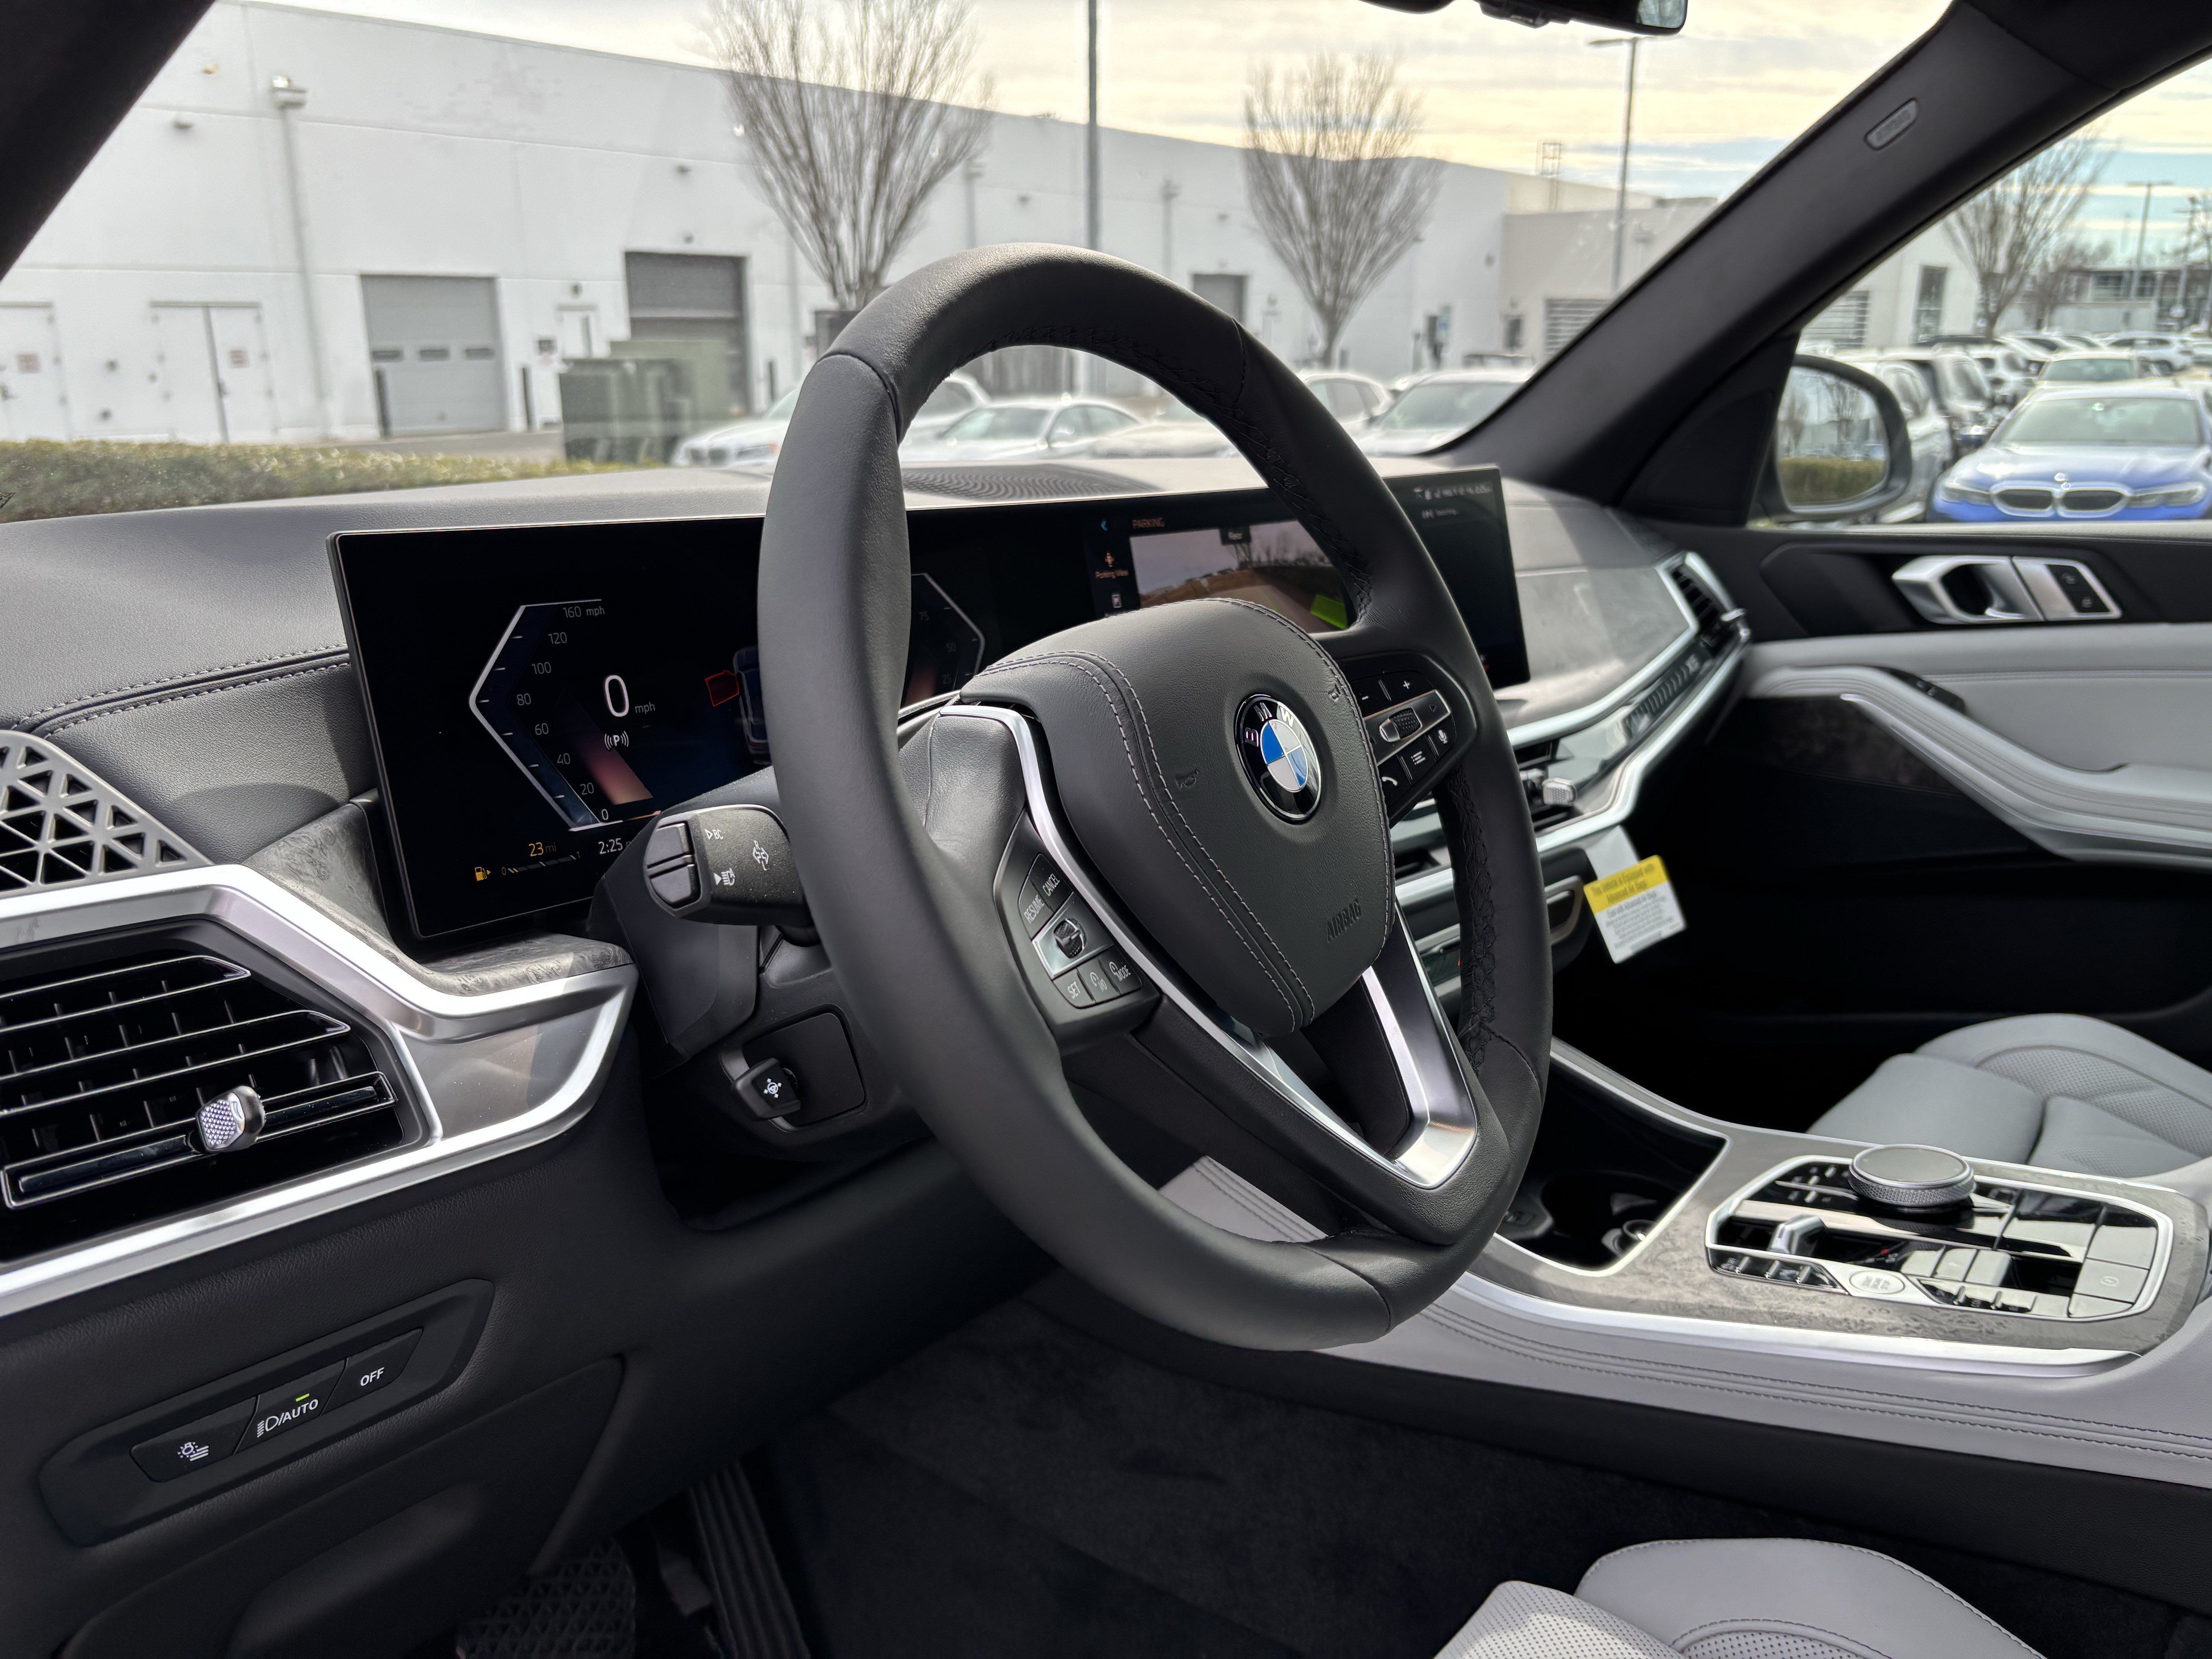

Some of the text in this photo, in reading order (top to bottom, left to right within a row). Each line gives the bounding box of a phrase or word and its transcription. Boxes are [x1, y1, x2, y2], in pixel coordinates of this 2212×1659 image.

[563, 606, 605, 618] 160 mph
[548, 632, 567, 644] 120
[531, 662, 551, 675] 100
[517, 693, 531, 706] 80
[605, 675, 629, 717] 0
[635, 702, 656, 713] mph
[535, 723, 549, 735] 60
[1244, 702, 1294, 747] BMW
[557, 753, 571, 765] 40
[580, 783, 594, 795] 20
[601, 809, 609, 821] 0
[713, 829, 723, 840] BC
[528, 842, 557, 857] 23 mi
[598, 838, 623, 855] 2:25
[1042, 873, 1060, 896] CANCEL
[1024, 895, 1045, 924] RESUME
[1326, 899, 1362, 943] AIRBAG
[1115, 965, 1131, 981] MODE
[1068, 981, 1081, 1000] SET
[360, 1367, 385, 1386] OFF
